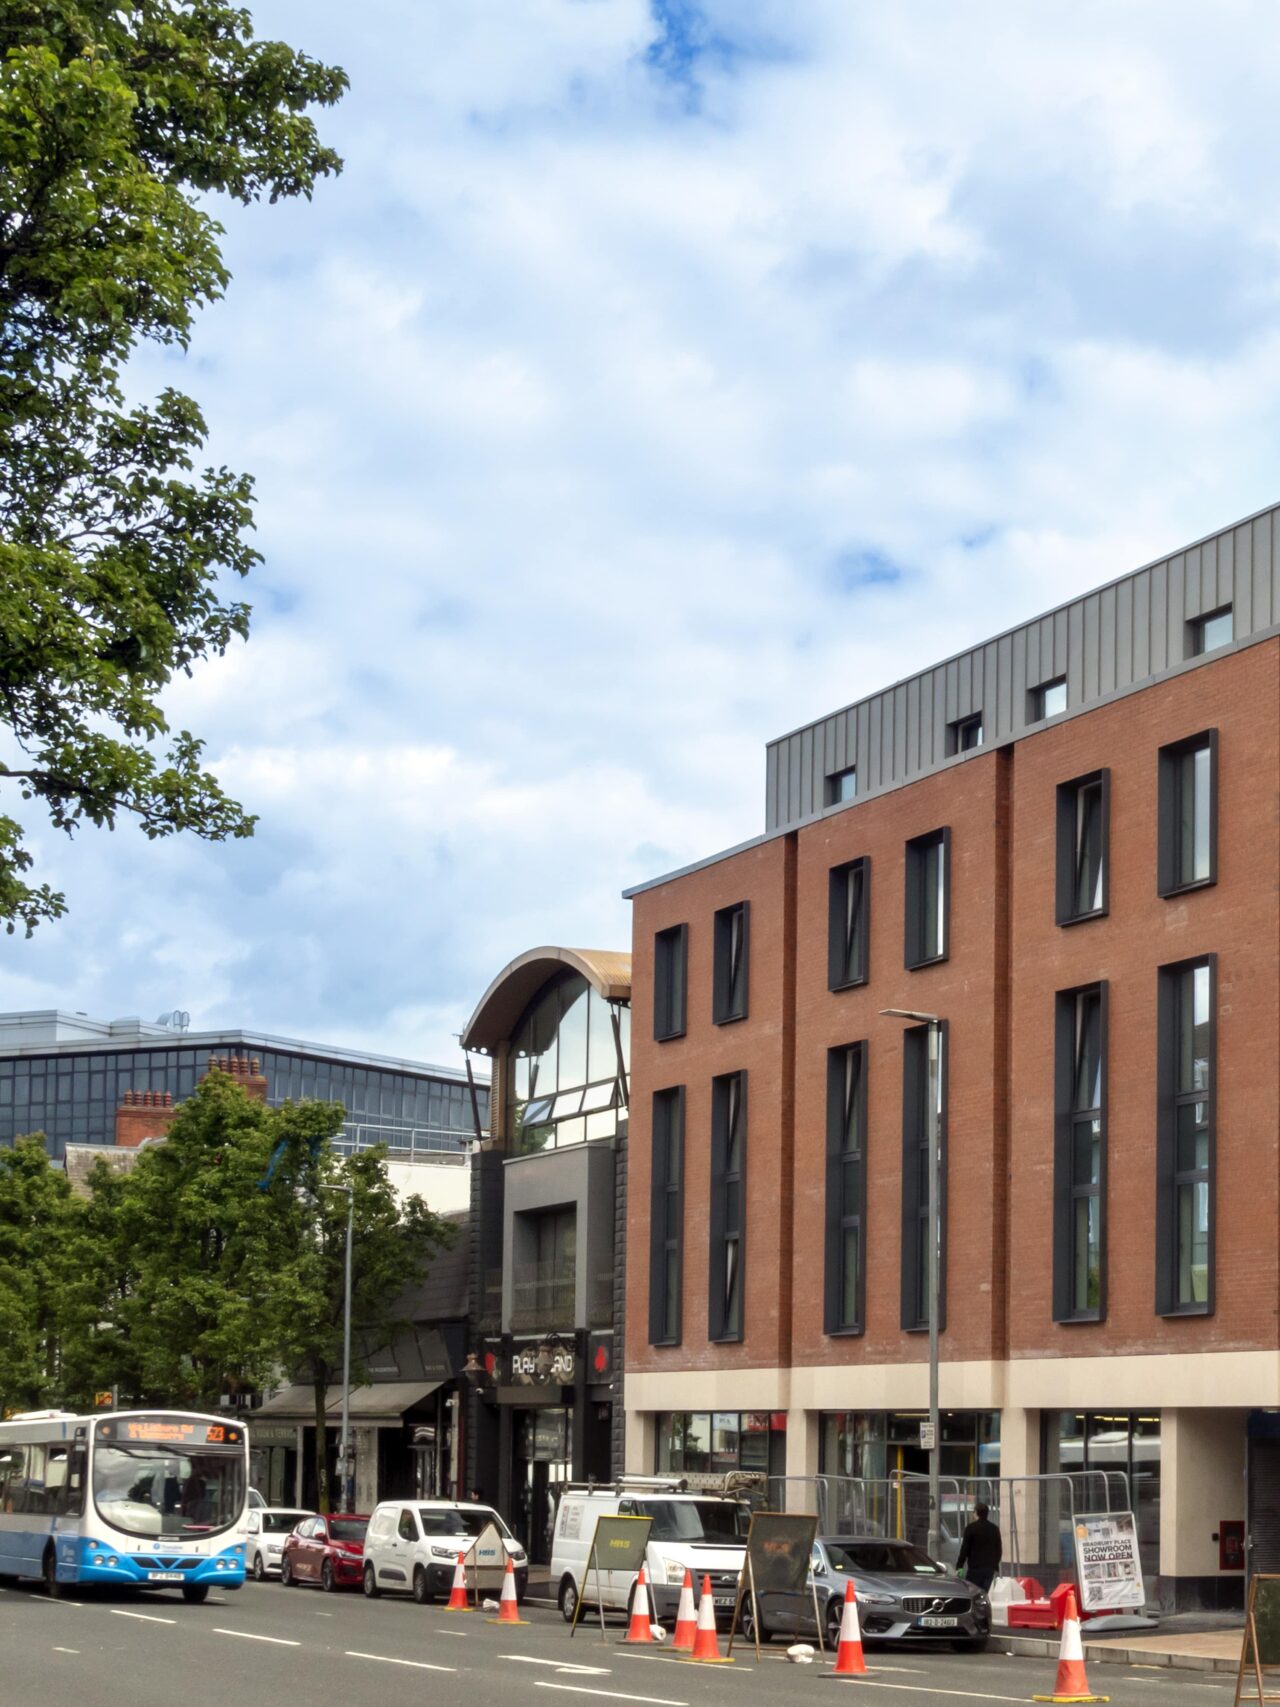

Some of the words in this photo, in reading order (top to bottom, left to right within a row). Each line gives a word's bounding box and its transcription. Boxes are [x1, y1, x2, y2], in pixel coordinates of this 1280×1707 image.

[512, 1355, 535, 1373] PLAY
[207, 1426, 225, 1440] 523
[1083, 1545, 1132, 1554] SHOWROOM
[1084, 1554, 1106, 1562] NOW
[1108, 1552, 1134, 1560] OPEN
